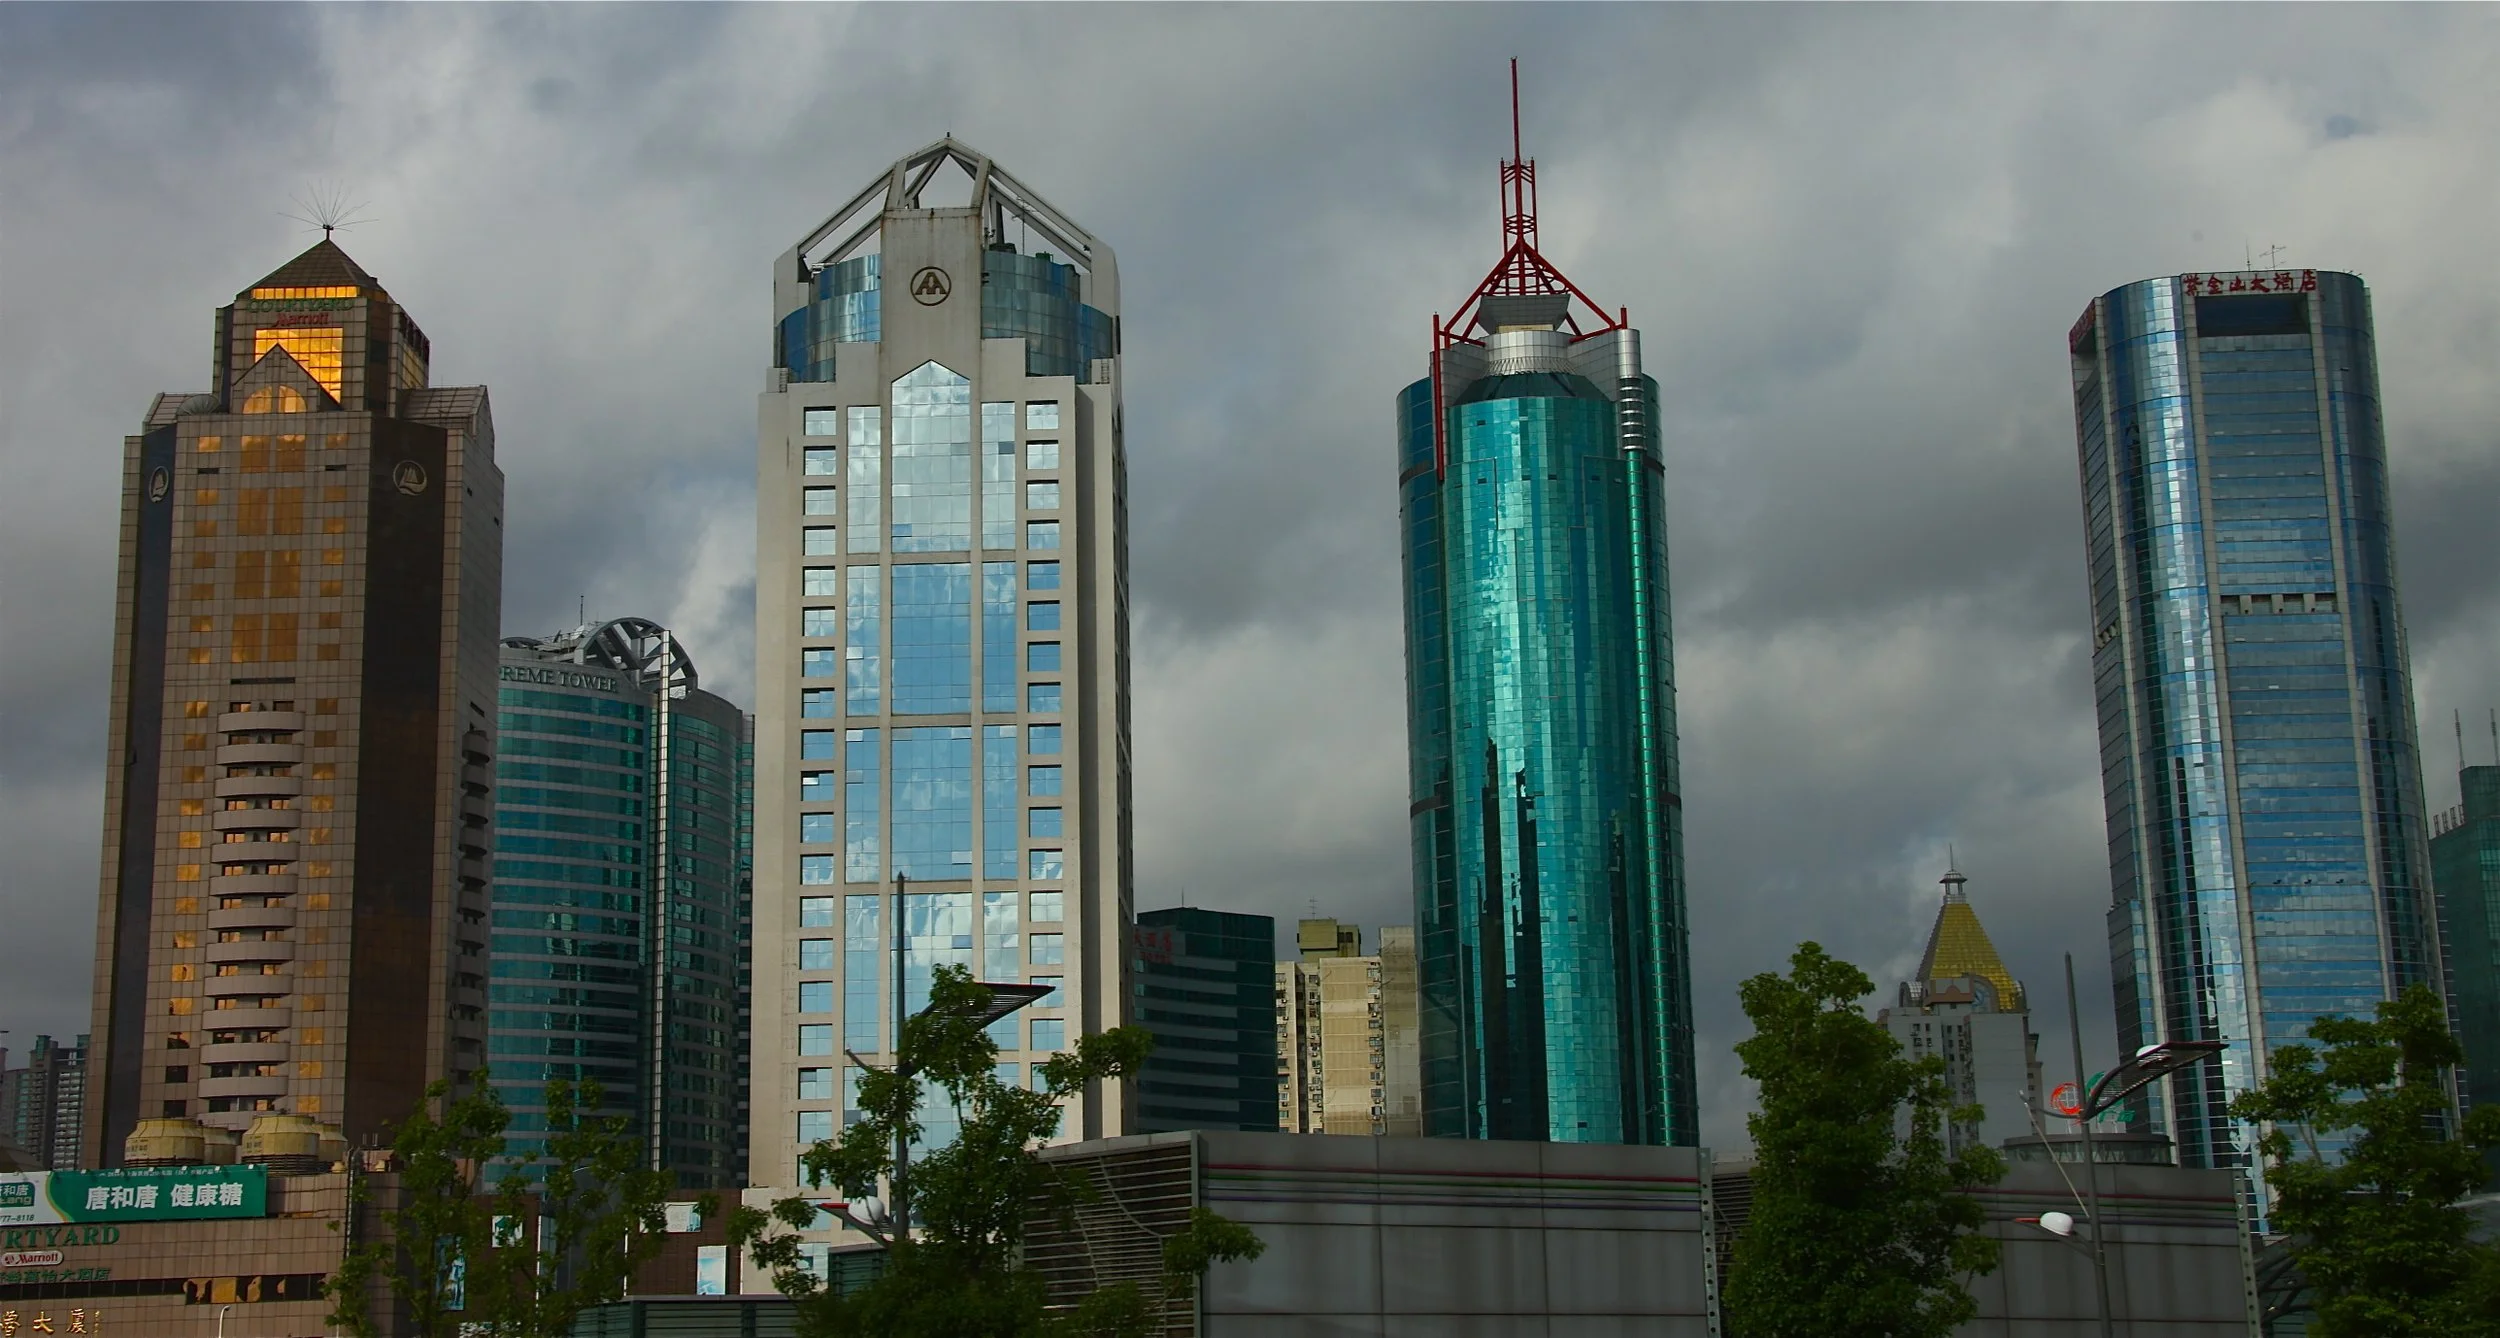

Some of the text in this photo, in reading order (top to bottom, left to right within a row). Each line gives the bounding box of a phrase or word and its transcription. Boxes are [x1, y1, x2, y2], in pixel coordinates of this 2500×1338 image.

[2183, 269, 2317, 296] 紫金山大酒店
[248, 299, 354, 312] COURTYARD
[499, 666, 619, 693] REME TOWER
[0, 1183, 29, 1196] 和唐
[85, 1182, 243, 1211] 唐和唐 健康糖
[0, 1225, 119, 1248] RTYARD
